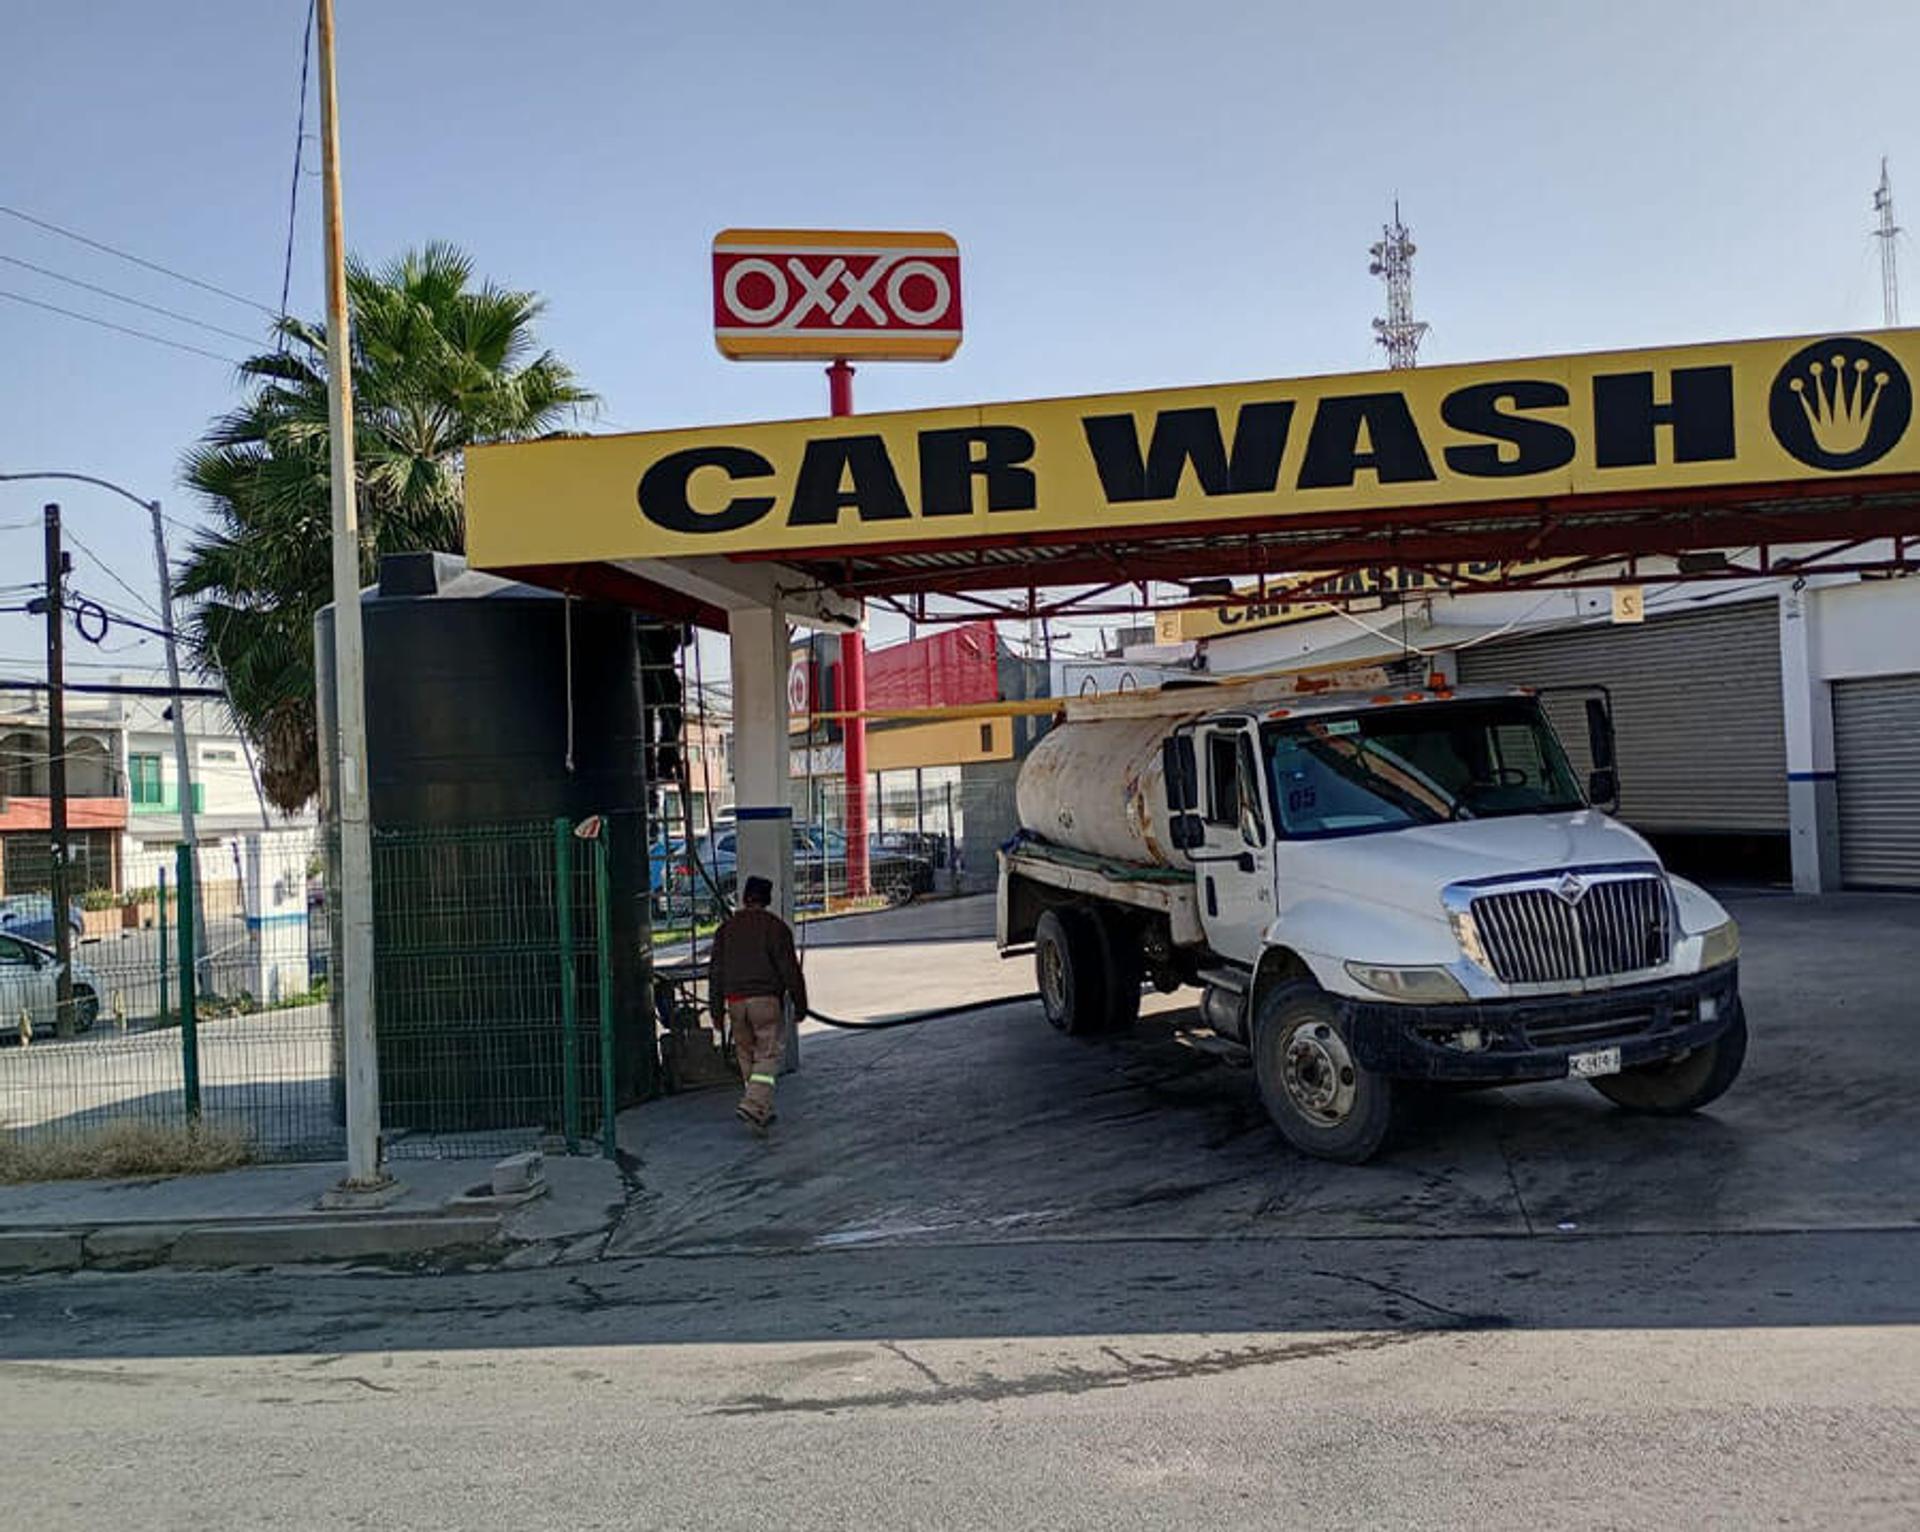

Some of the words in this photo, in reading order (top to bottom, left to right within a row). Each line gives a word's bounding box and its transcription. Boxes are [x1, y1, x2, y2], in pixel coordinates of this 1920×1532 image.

[723, 256, 951, 326] OXXO
[637, 425, 1038, 534] CAR
[1080, 365, 1737, 504] WASH
